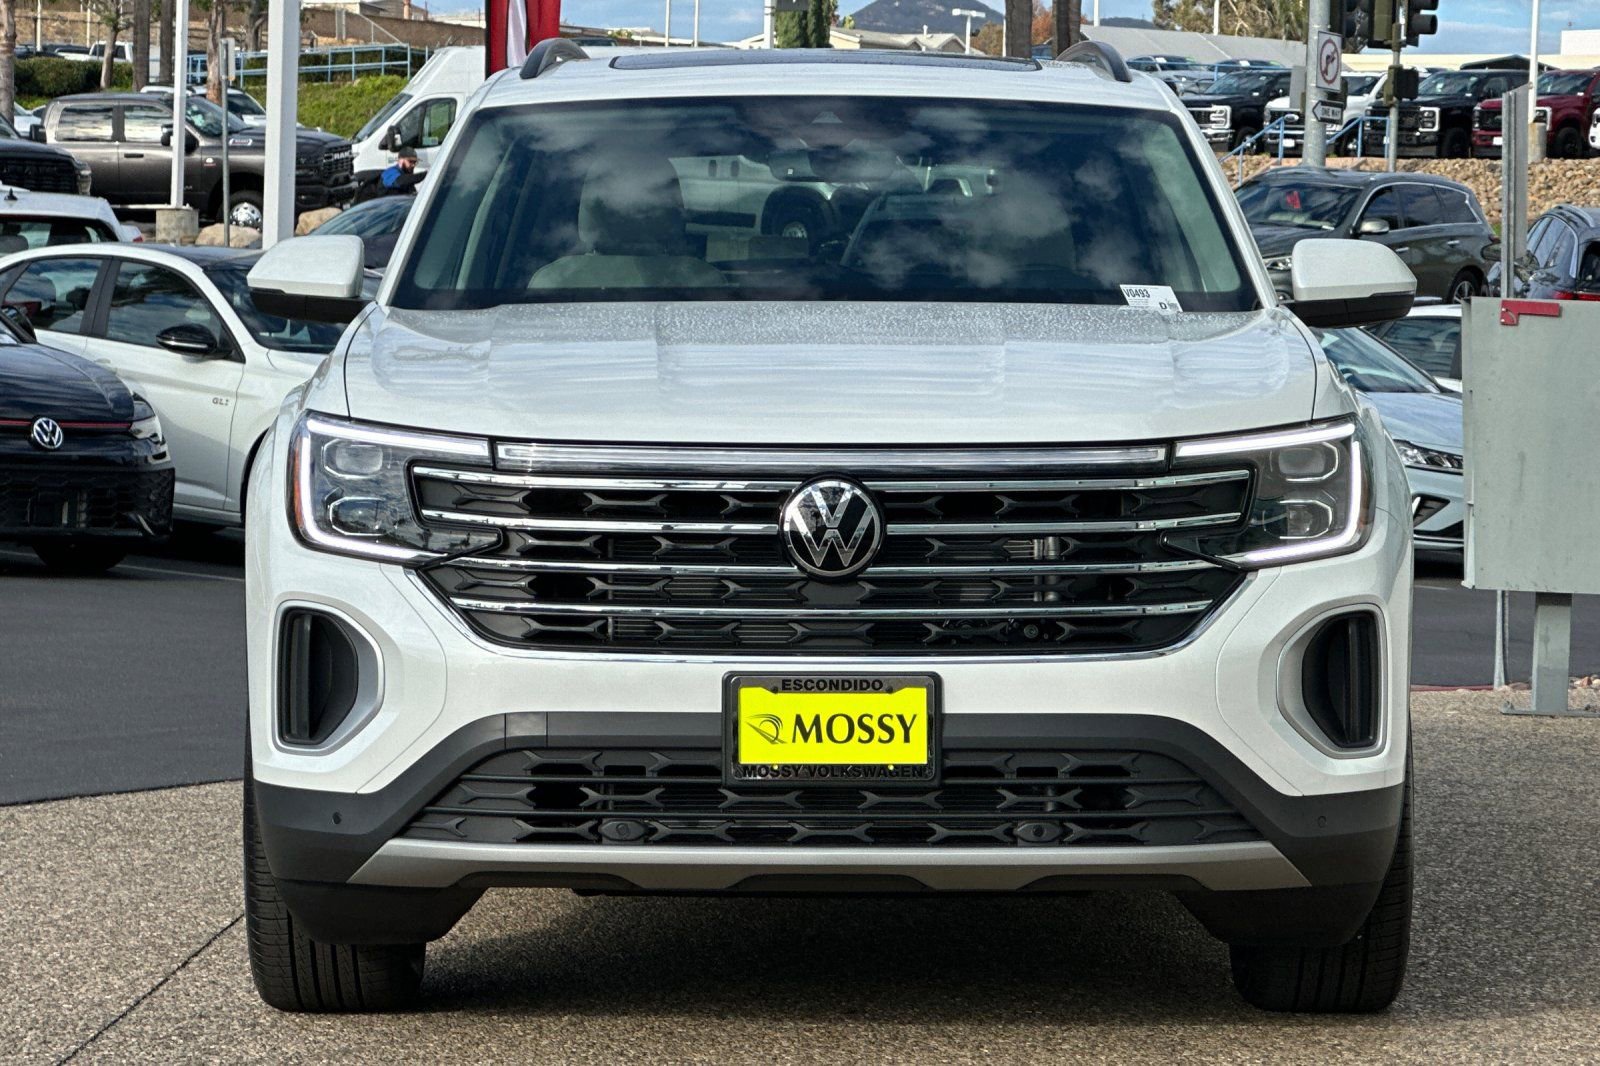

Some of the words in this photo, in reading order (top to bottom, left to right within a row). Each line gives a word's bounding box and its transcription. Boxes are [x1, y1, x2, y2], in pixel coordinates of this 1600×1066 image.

[1123, 288, 1151, 298] V0493
[782, 480, 881, 577] VW
[781, 678, 884, 692] ESCONDIDO
[791, 712, 918, 745] MOSSY
[742, 765, 802, 778] MOSSY
[807, 764, 924, 778] VOLKSWAGEN
